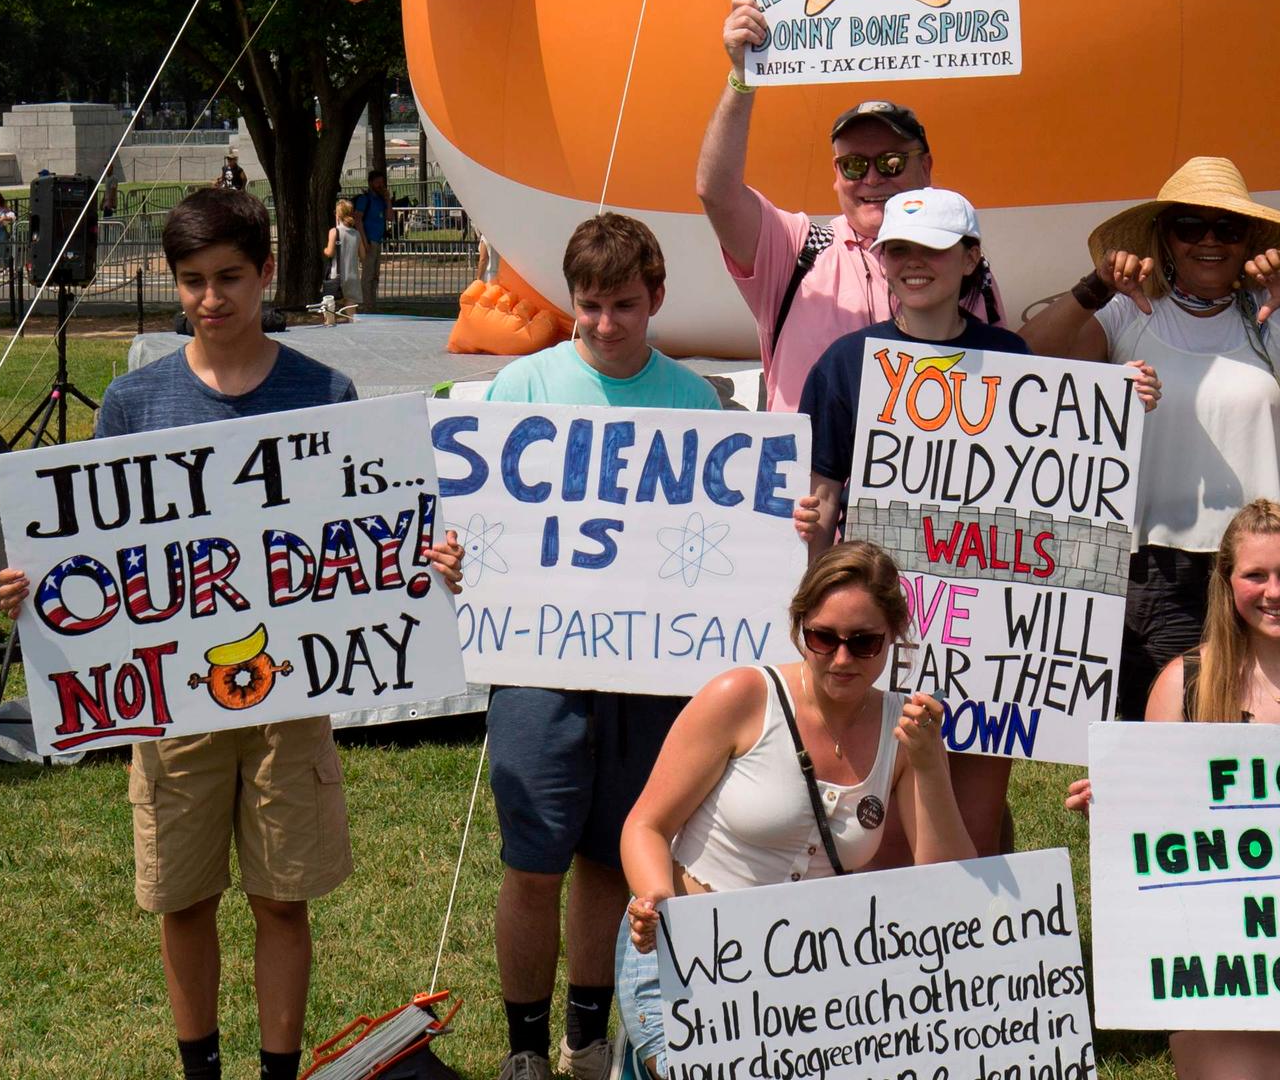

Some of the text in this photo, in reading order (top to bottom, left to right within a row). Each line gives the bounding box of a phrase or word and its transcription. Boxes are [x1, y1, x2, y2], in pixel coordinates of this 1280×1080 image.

[756, 60, 806, 76] RAPIST
[820, 58, 855, 74] TAX
[858, 55, 921, 71] CHEAT
[932, 51, 1014, 69] TRAITOR
[850, 13, 910, 48] BONE
[917, 9, 1009, 45] SPURS
[873, 348, 1133, 451] YOU CAN
[26, 446, 215, 539] JULY
[431, 415, 798, 518] SCIENCE
[862, 429, 1130, 520] BUILD YOUR
[34, 492, 436, 636] OUR DAY!
[540, 515, 624, 570] IS
[923, 516, 1056, 578] WALLS
[456, 603, 771, 662] ON-PARTISAN
[1004, 587, 1108, 664] WILL
[48, 612, 420, 735] NOT DAY
[889, 643, 1113, 721] EAR THEM
[658, 883, 1072, 988] We Can disagree and
[668, 998, 741, 1051] Still
[752, 990, 818, 1038] love
[824, 978, 907, 1031] each
[1007, 960, 1086, 1001] unless
[954, 1008, 1039, 1051] rooted
[1048, 1009, 1080, 1039] in
